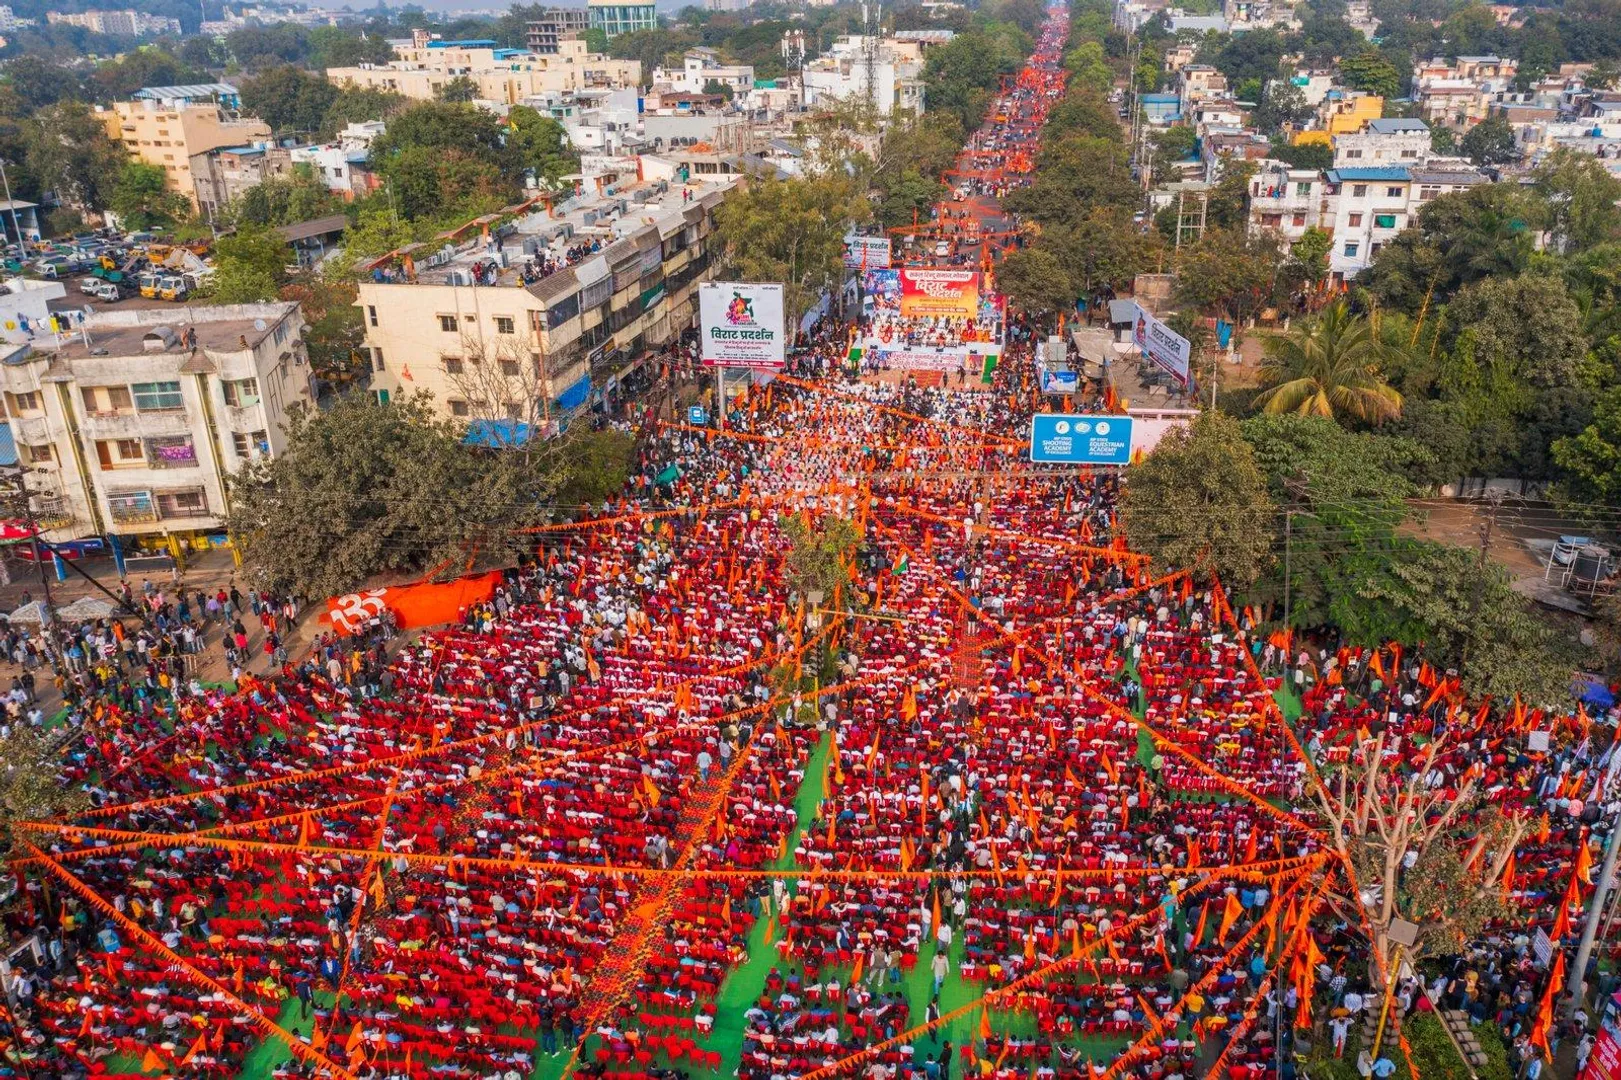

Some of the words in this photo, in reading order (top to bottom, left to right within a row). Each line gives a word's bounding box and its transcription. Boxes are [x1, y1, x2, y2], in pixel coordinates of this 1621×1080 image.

[914, 280, 948, 294] विराट
[711, 326, 738, 340] विराट
[740, 328, 774, 340] प्रदर्शन
